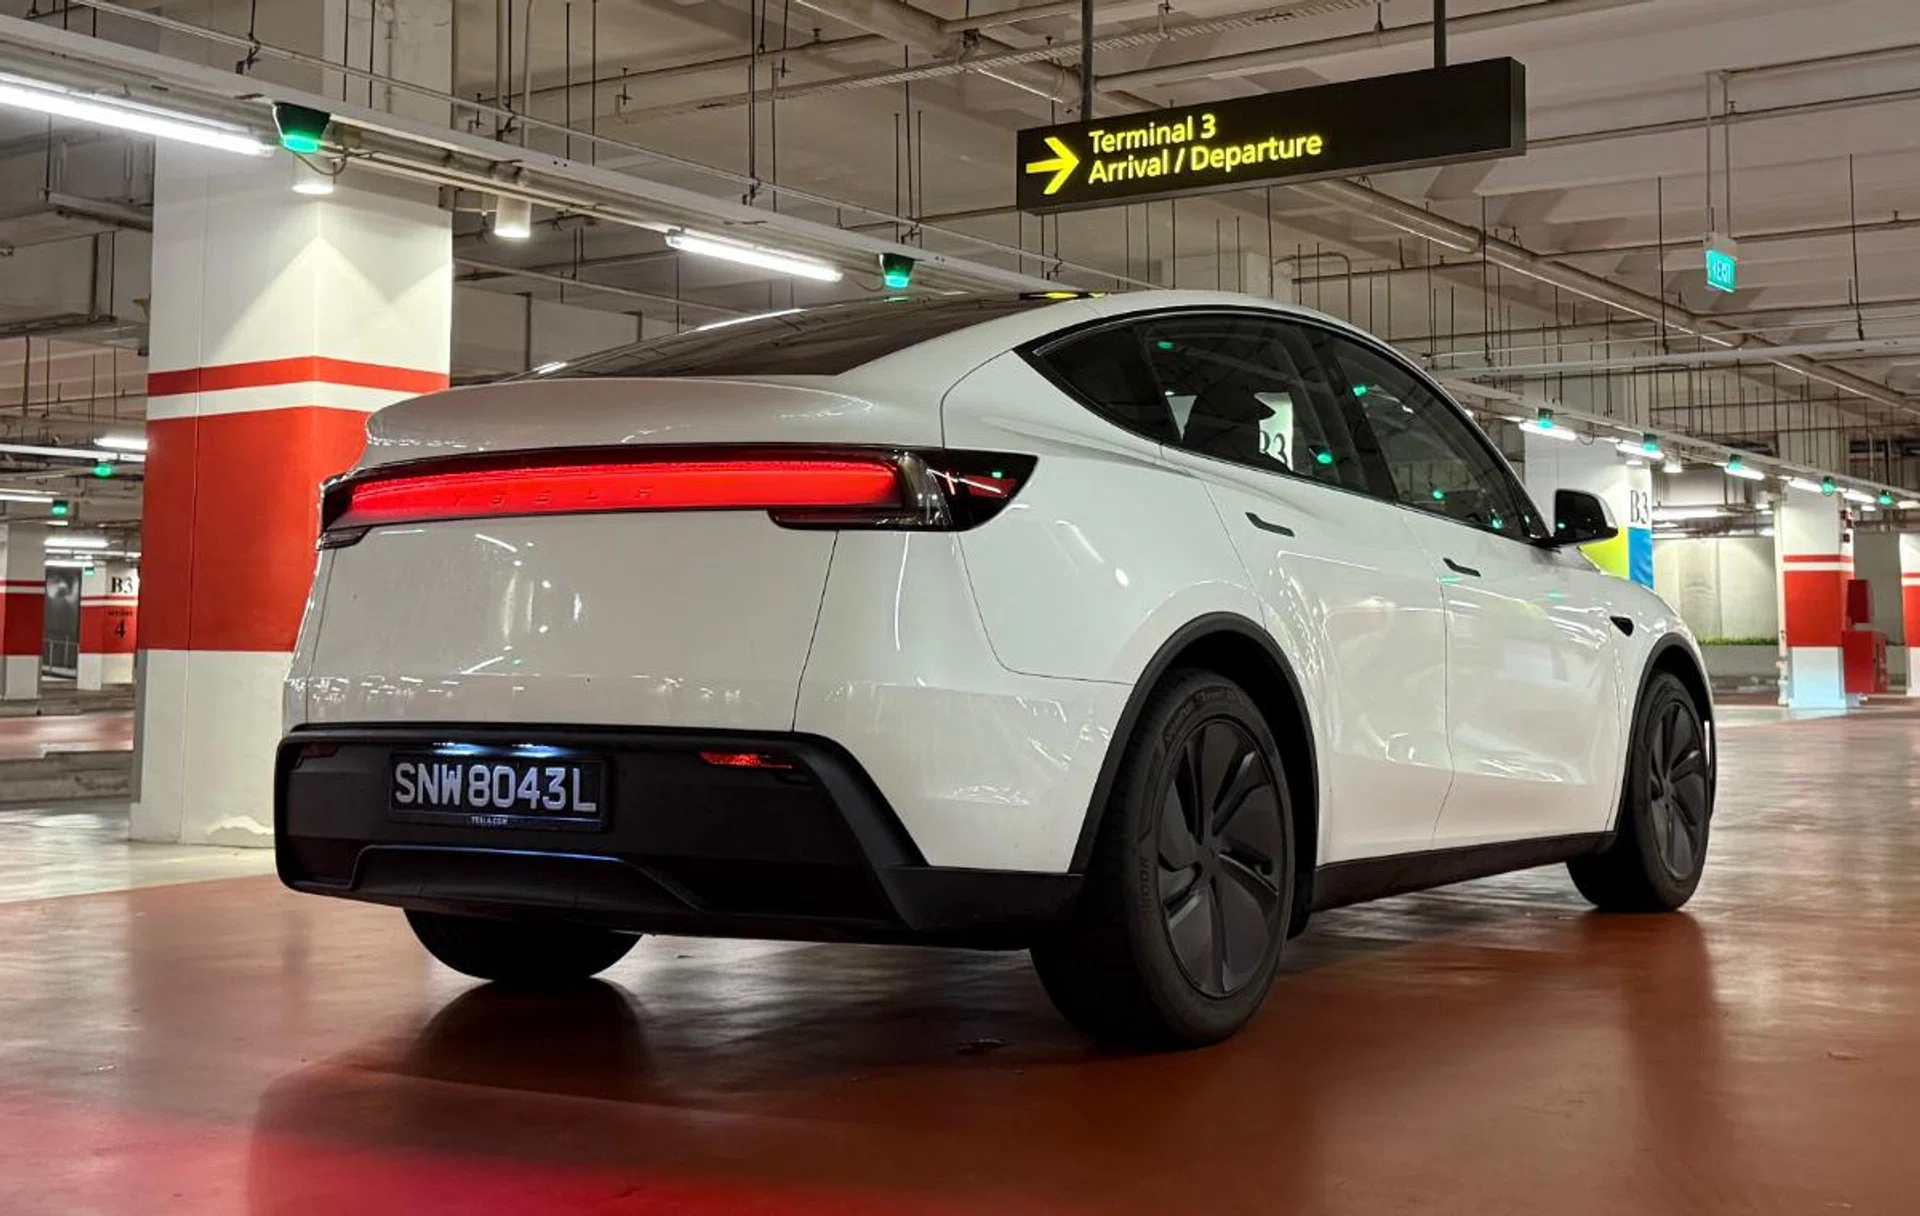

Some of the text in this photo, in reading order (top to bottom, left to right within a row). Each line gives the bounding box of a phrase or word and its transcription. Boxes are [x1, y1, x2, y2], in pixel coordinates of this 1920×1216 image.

[1088, 113, 1216, 154] Terminal 3
[1088, 134, 1322, 184] Arrival / Departure
[1630, 489, 1650, 525] B3
[111, 576, 133, 594] B3
[115, 617, 126, 639] 4
[471, 815, 508, 826] TESLA.COM
